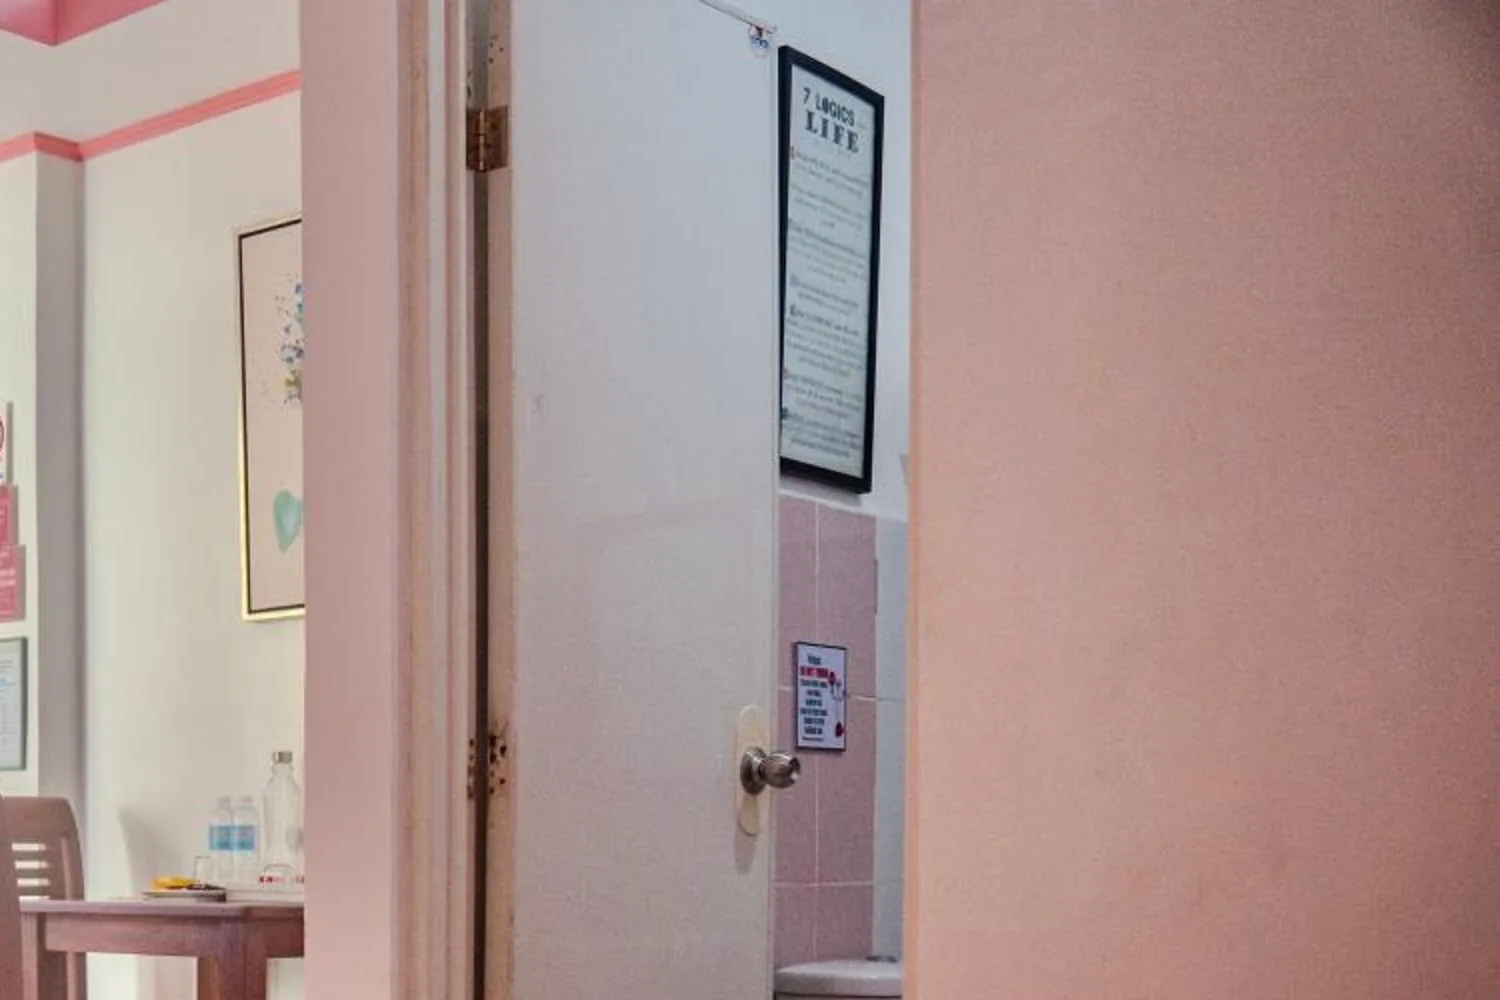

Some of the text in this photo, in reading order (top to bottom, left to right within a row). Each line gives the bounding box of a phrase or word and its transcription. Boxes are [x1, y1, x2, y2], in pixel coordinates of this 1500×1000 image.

[803, 87, 855, 127] 7 LOGICS
[804, 109, 859, 154] LIFE
